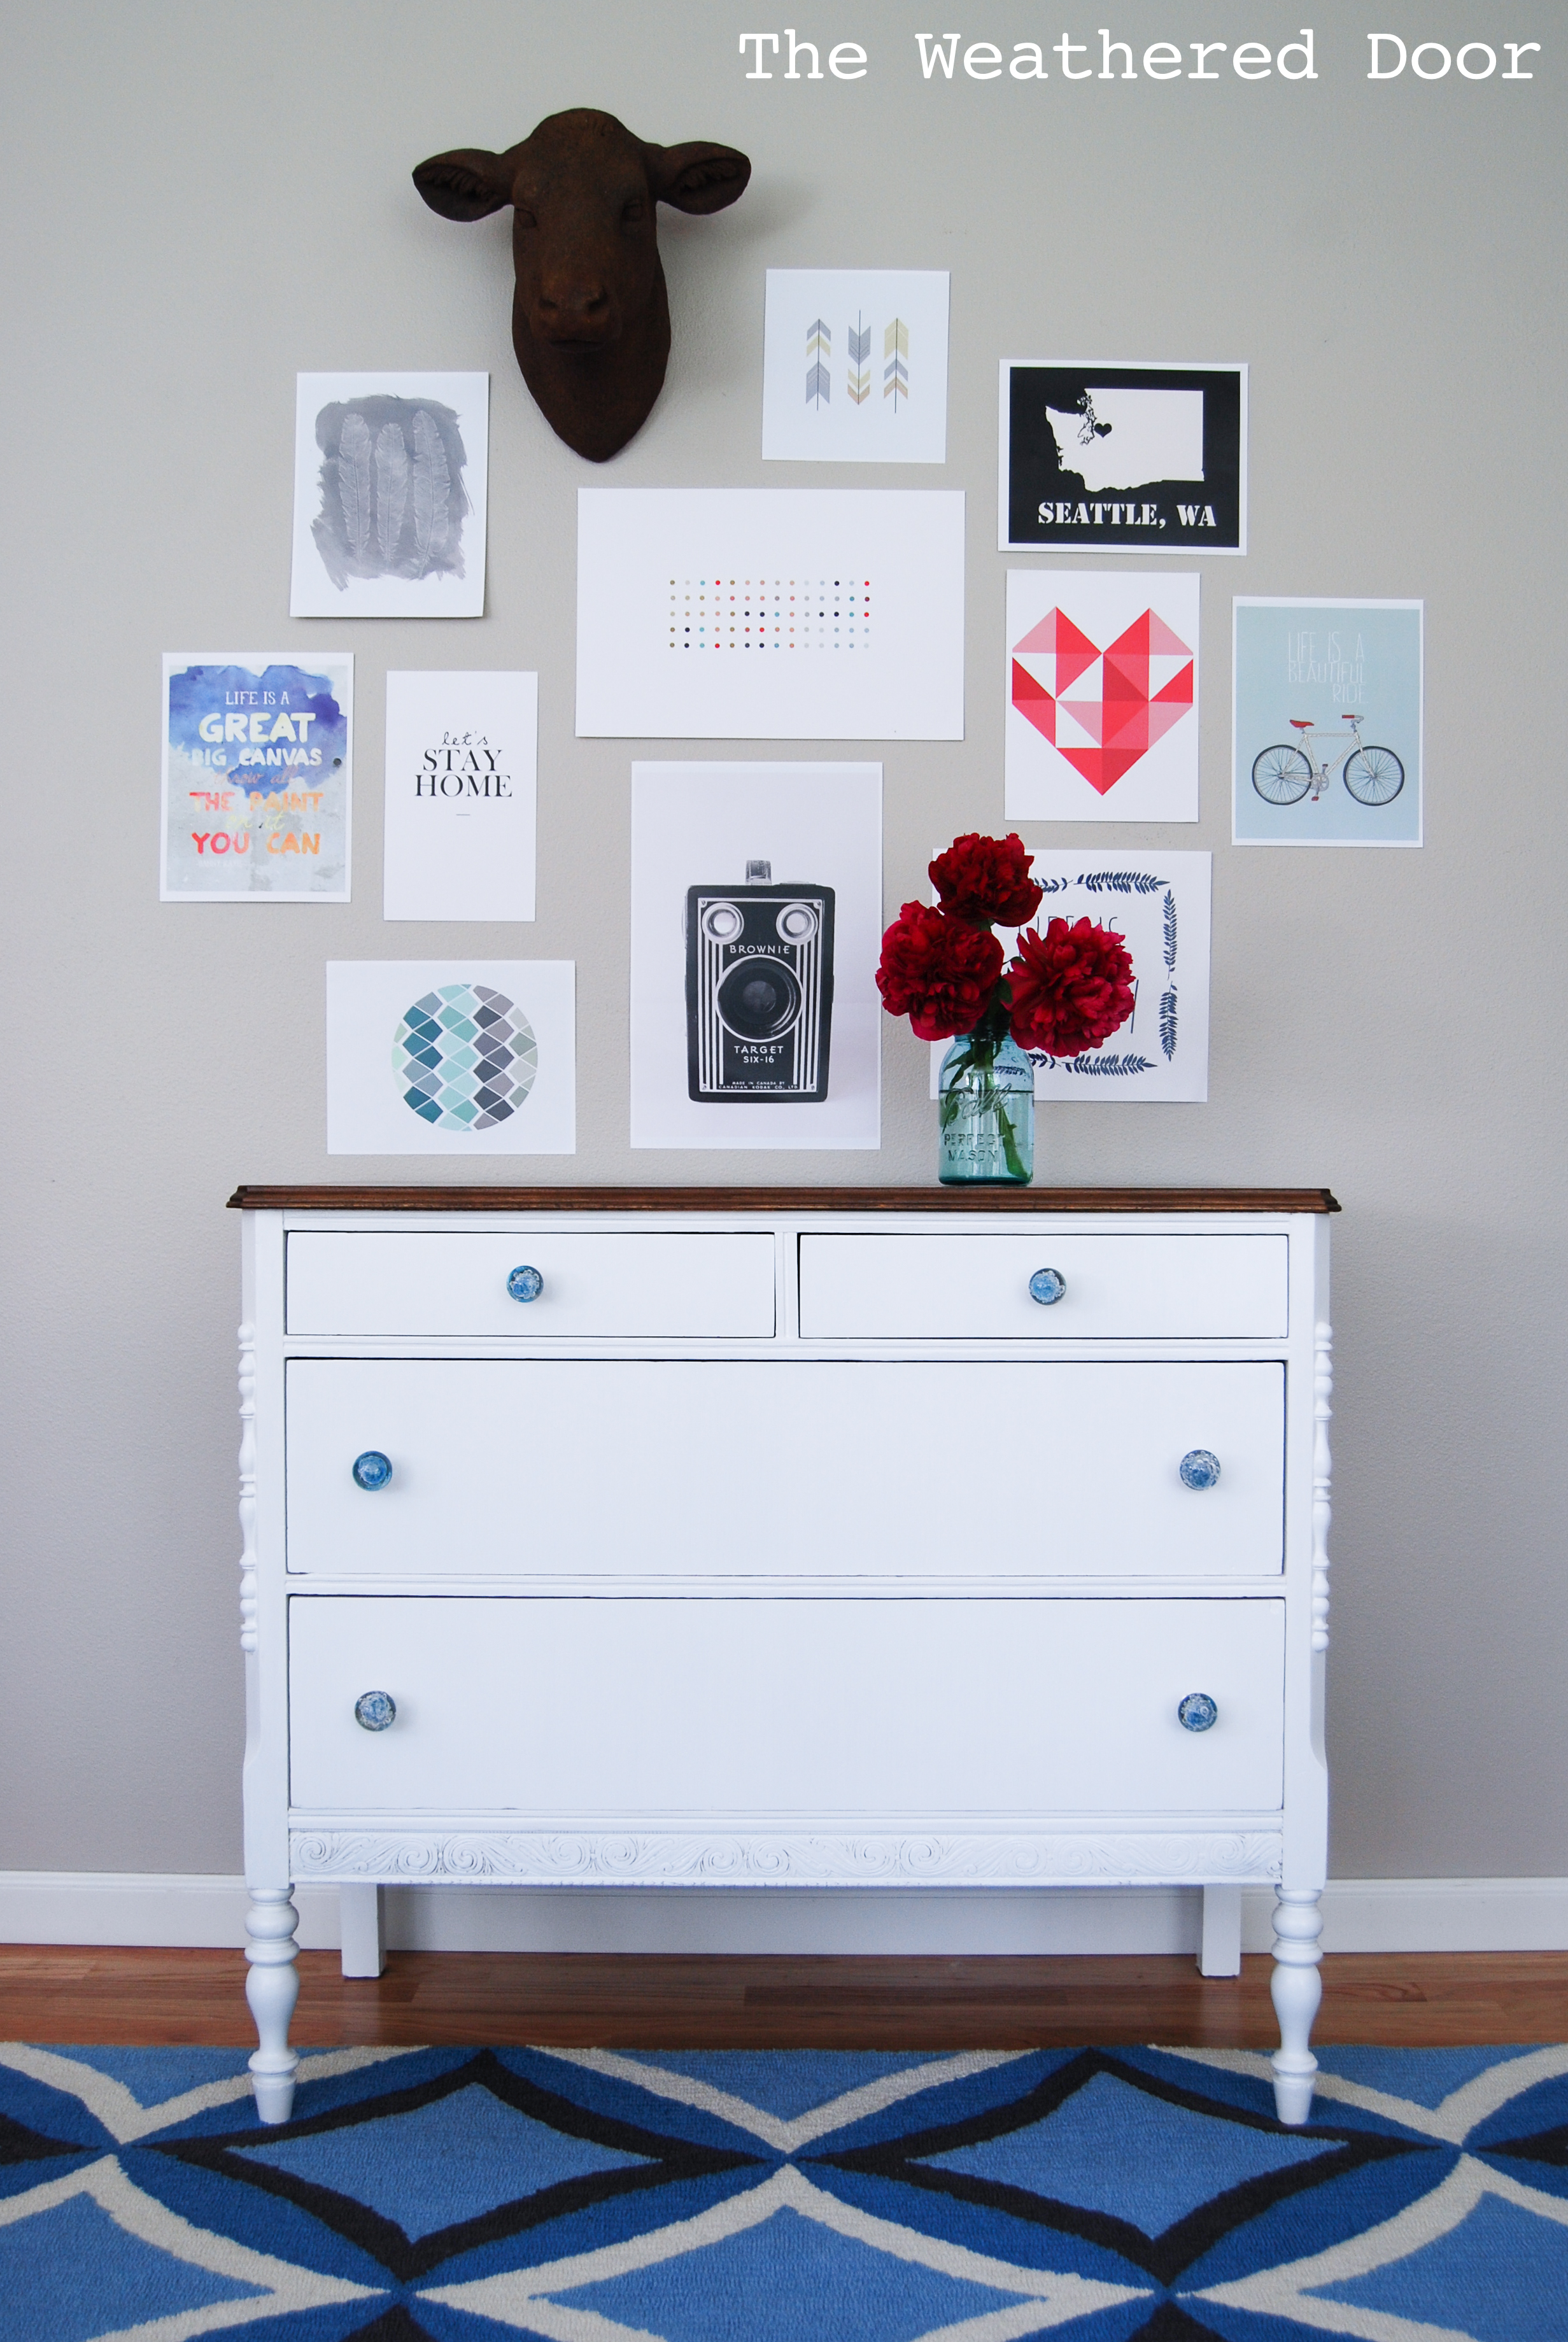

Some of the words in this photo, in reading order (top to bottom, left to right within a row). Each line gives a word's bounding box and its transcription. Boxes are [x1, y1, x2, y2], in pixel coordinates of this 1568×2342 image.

[1038, 502, 1166, 529] SEATTLE,
[1176, 505, 1217, 527] WA
[1288, 631, 1317, 663] LIFE
[1327, 631, 1341, 663] IS
[1355, 632, 1365, 662] A
[1288, 661, 1367, 684] BEAUTIFUL
[225, 691, 258, 705] LIFE
[263, 691, 276, 705] IS
[280, 691, 290, 705] A
[199, 712, 316, 743] GREAT
[442, 730, 488, 746] let's
[191, 747, 227, 766] BIG
[238, 747, 323, 767] CANVAS
[422, 748, 502, 772] STAY
[414, 773, 512, 797] HOME
[189, 791, 236, 812] THE
[250, 791, 324, 812] PAINT
[191, 831, 250, 855] YOU
[266, 831, 321, 855] CAN
[729, 944, 791, 954] BROWNIE
[733, 1045, 784, 1054] TARGET
[743, 1055, 775, 1064] SIX-16
[943, 1133, 1006, 1146] PERFECT
[947, 1149, 998, 1162] MASON
